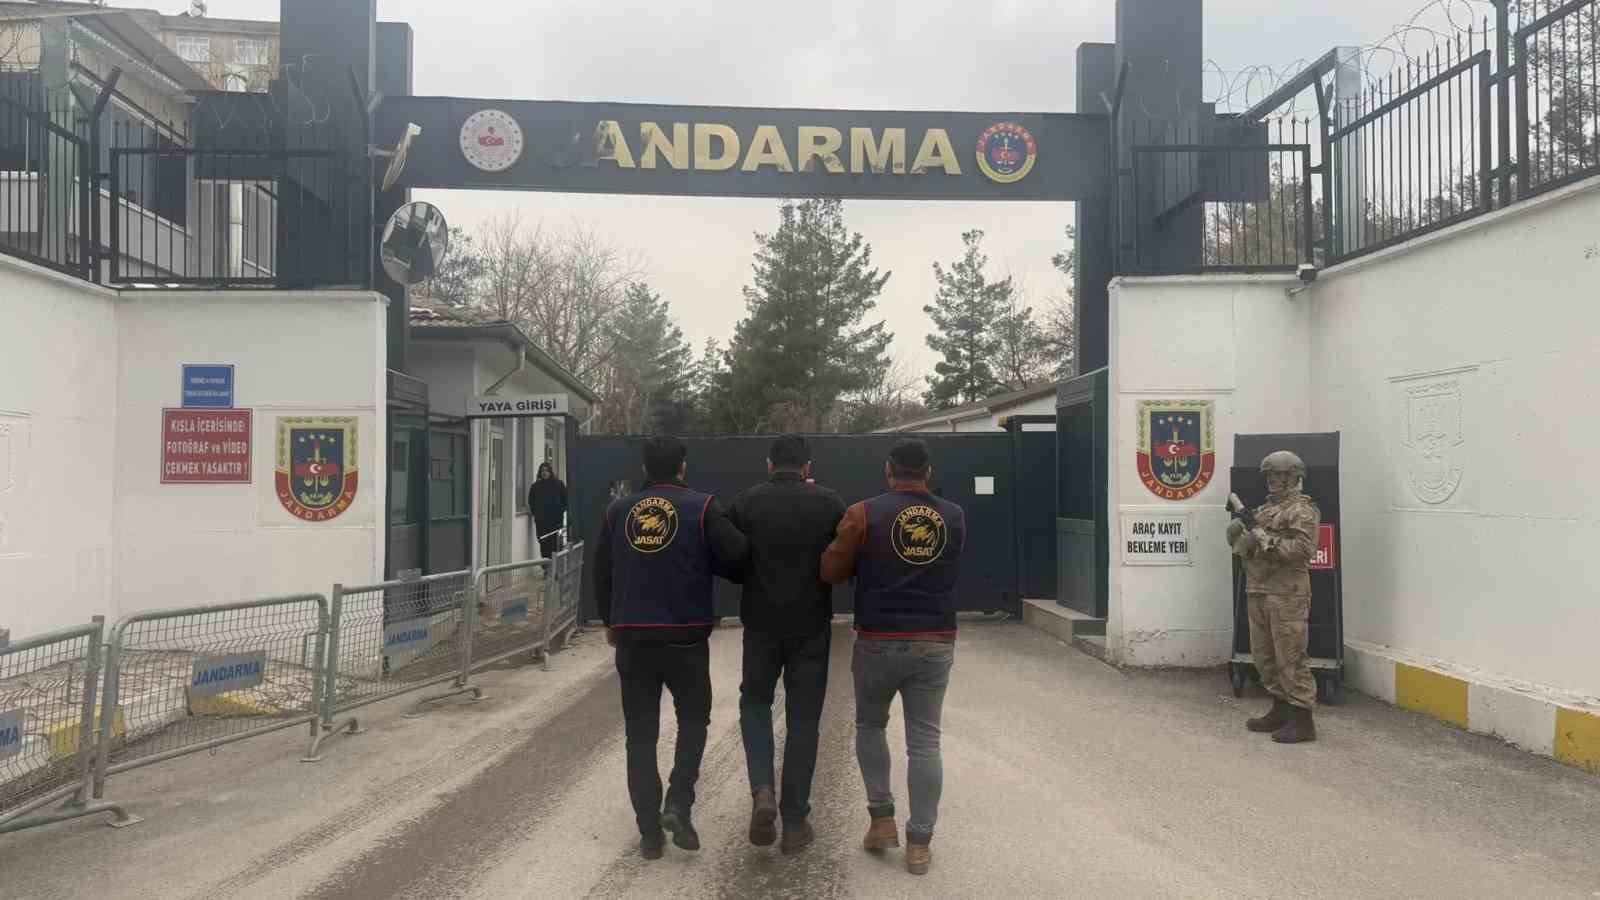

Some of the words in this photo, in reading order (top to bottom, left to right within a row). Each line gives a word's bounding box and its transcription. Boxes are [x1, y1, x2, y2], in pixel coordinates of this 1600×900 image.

[543, 120, 962, 176] ANDARMA
[480, 401, 512, 412] YAYA
[223, 437, 248, 454] VİDEO
[202, 461, 241, 475] YASAKTIR
[1142, 471, 1211, 498] JANDARMA
[280, 489, 354, 519] JANDARMA
[632, 497, 674, 519] JANDARMA
[897, 506, 944, 528] JANDARMA
[1132, 522, 1156, 538] ARAÇ
[1158, 522, 1182, 535] KAYIT
[634, 536, 664, 545] JASAT
[1127, 541, 1166, 553] BEKLEME
[1168, 538, 1188, 553] YERİ
[903, 547, 935, 556] JASAT
[1310, 547, 1328, 564] ERİ
[193, 661, 261, 687] JANDARMA
[0, 725, 19, 747] MA
